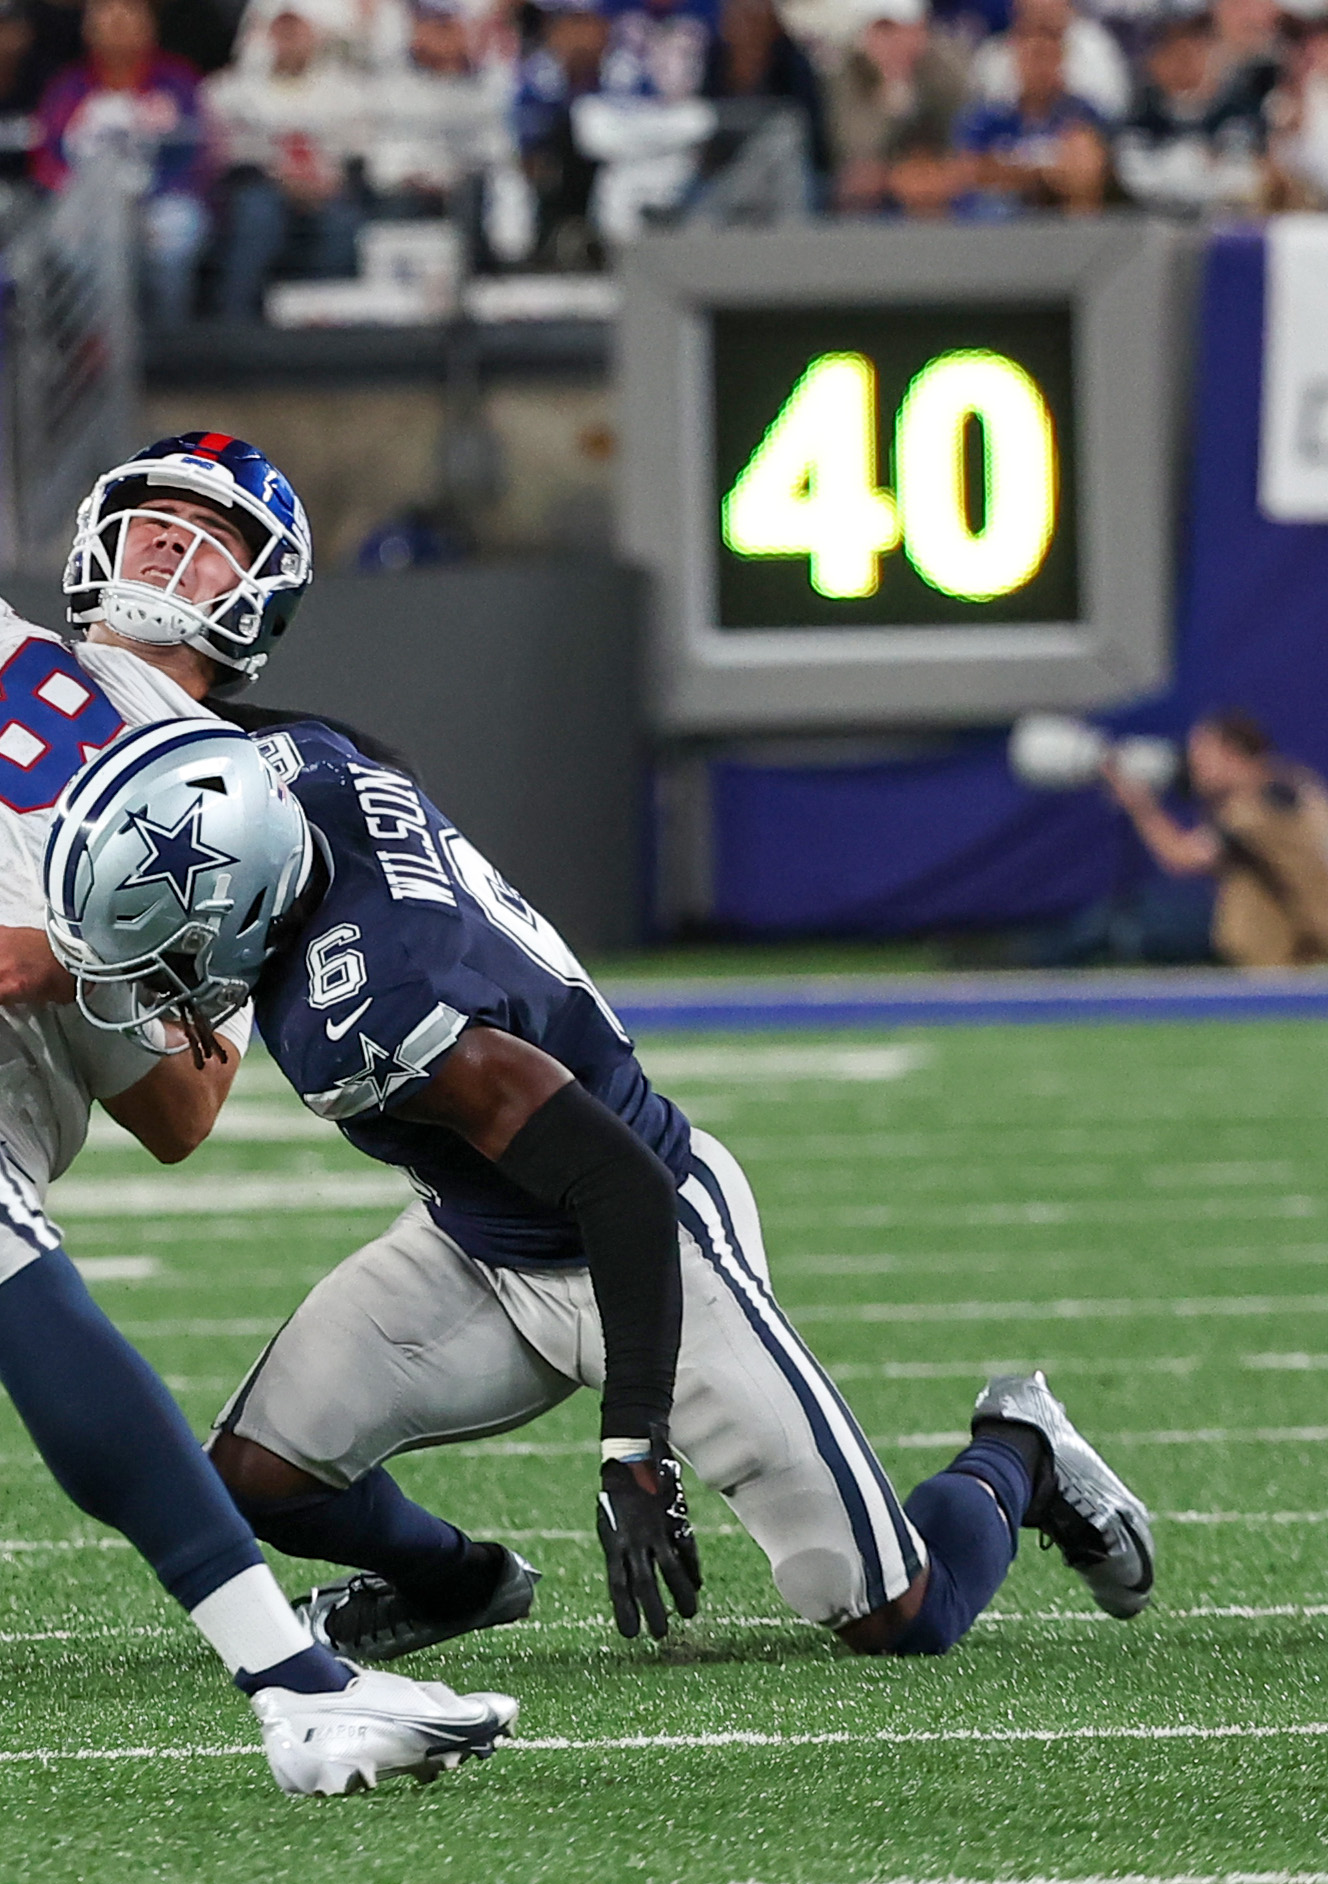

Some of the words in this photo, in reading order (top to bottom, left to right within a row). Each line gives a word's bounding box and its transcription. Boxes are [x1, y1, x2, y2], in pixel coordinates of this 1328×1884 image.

[722, 347, 1059, 603] 40
[347, 762, 457, 908] WILSON
[306, 922, 368, 1010] 6
